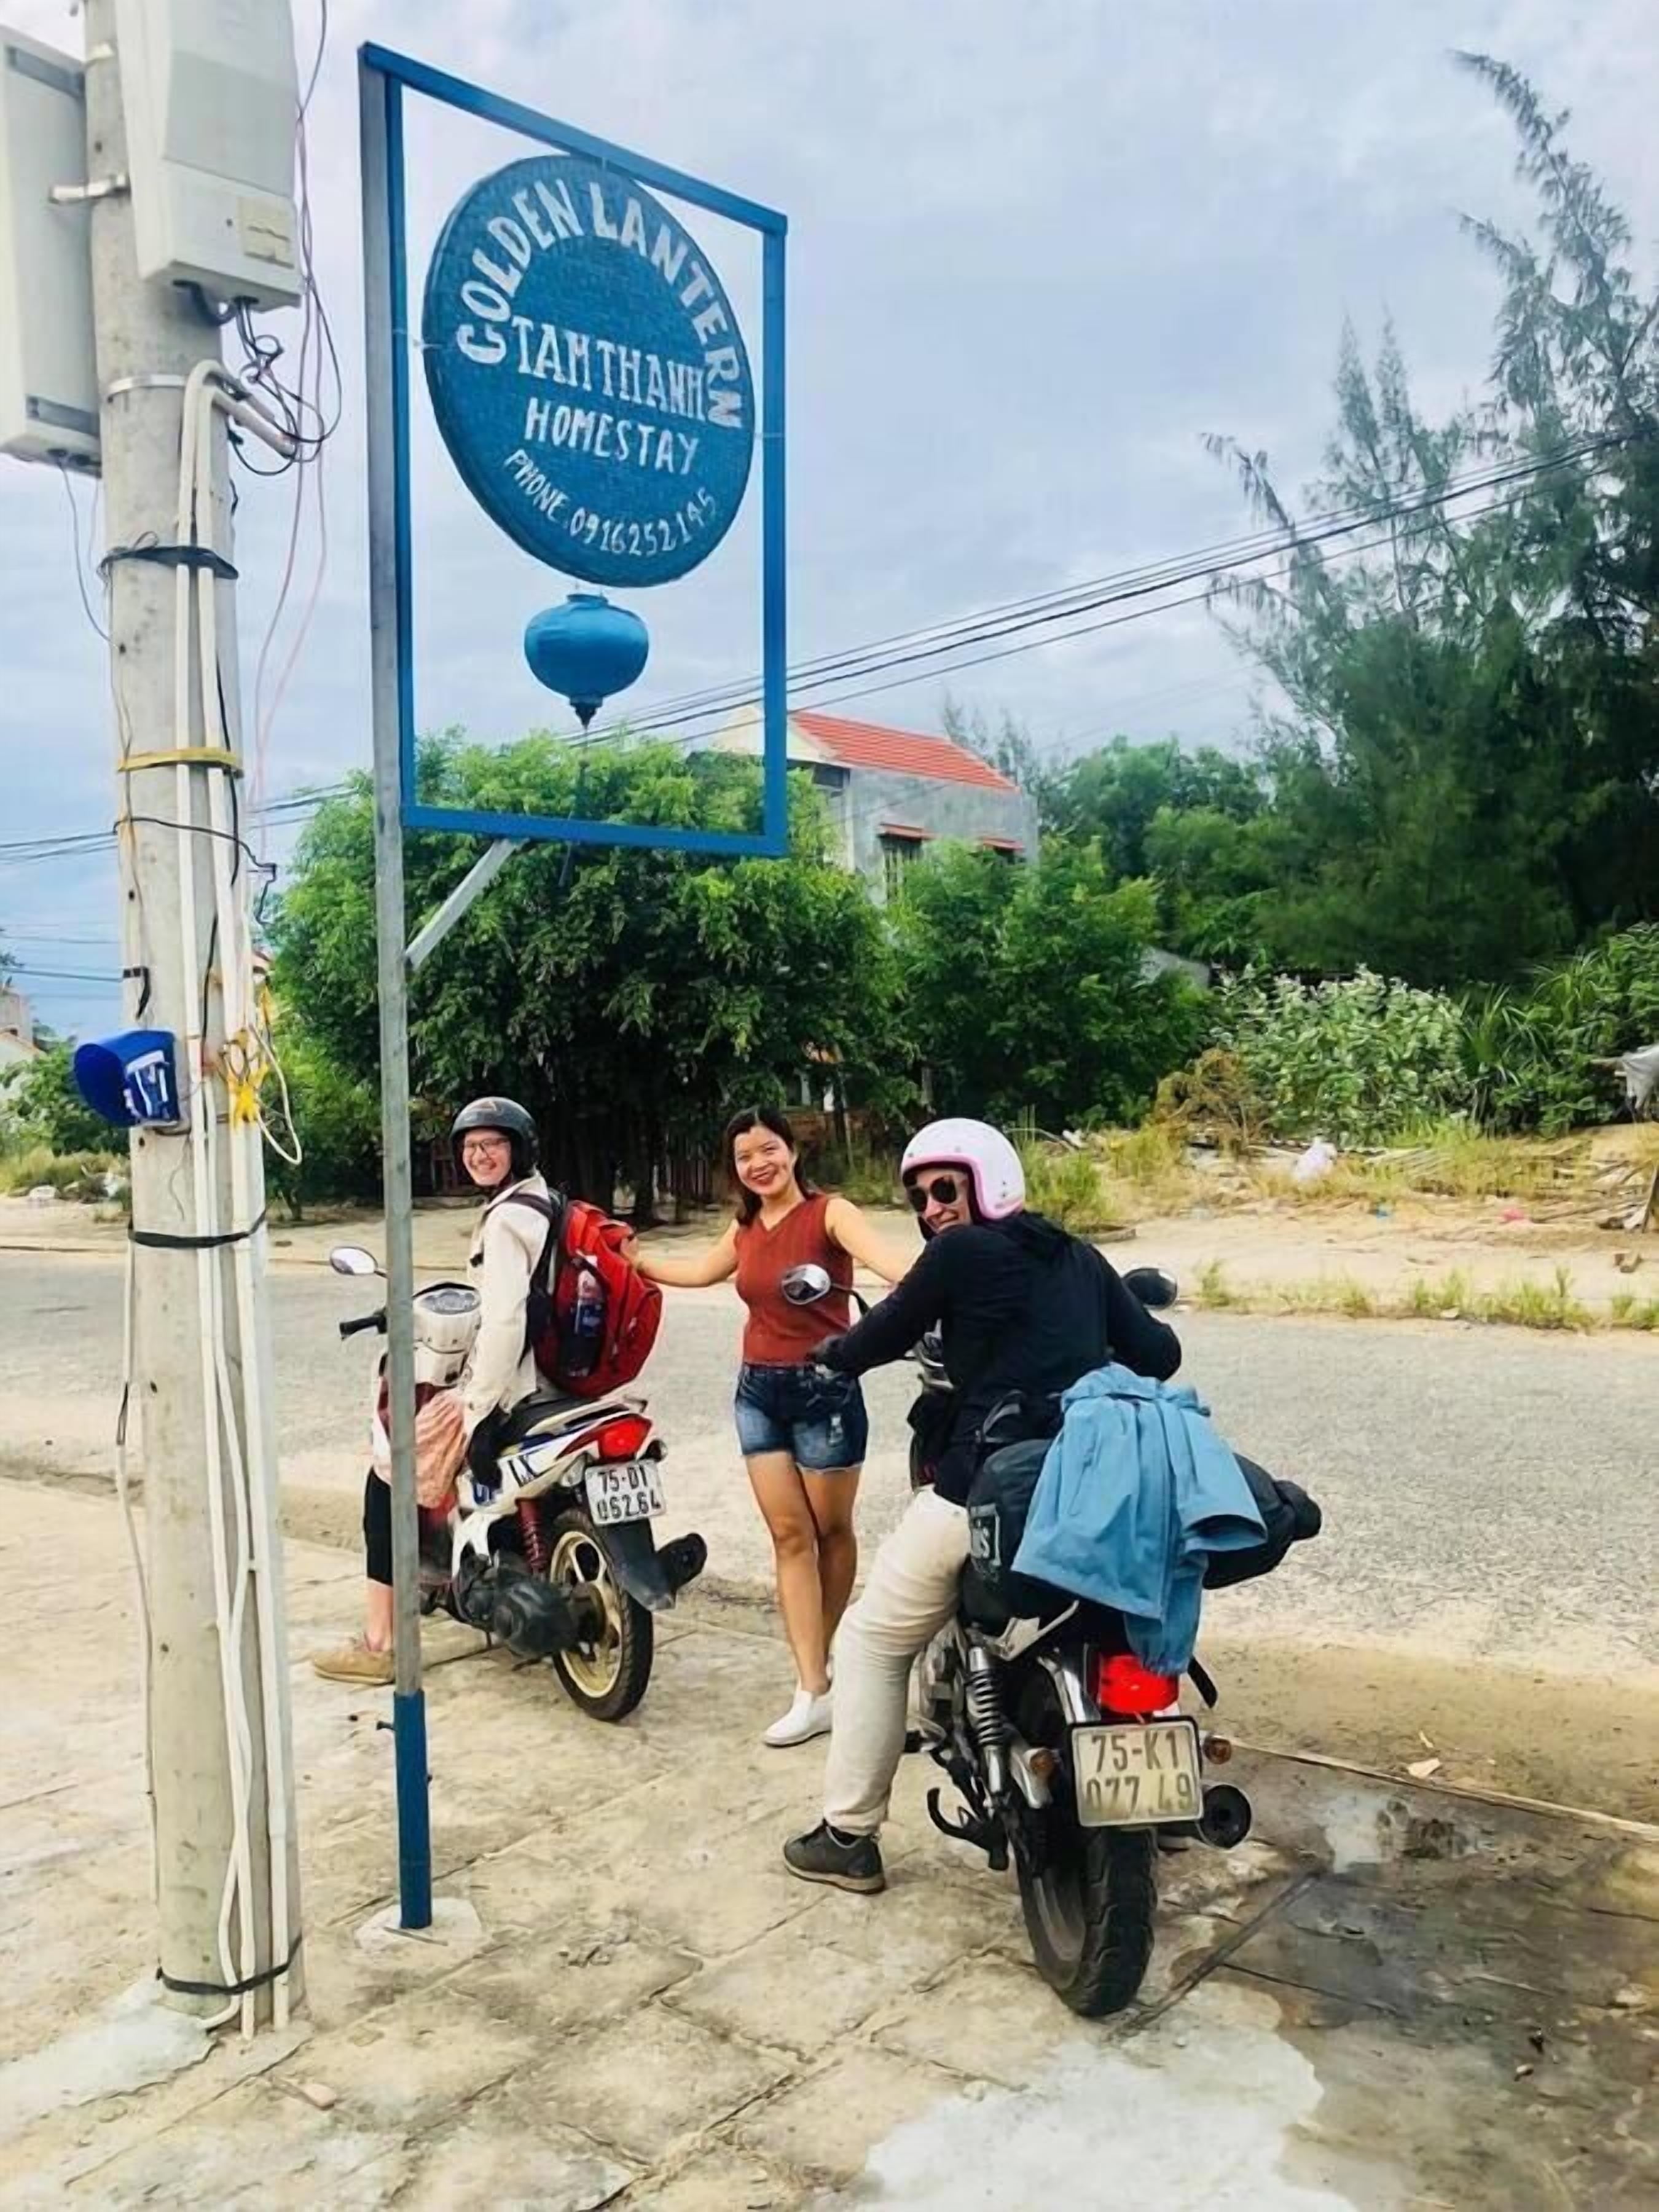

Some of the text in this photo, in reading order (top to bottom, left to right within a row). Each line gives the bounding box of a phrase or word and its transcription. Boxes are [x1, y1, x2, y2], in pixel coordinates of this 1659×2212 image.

[457, 178, 742, 428] GOLDEN LANTERN
[512, 315, 706, 423] TAM THANH
[524, 396, 699, 476] HOMESTAY
[1092, 1730, 1179, 1773] 75-K1
